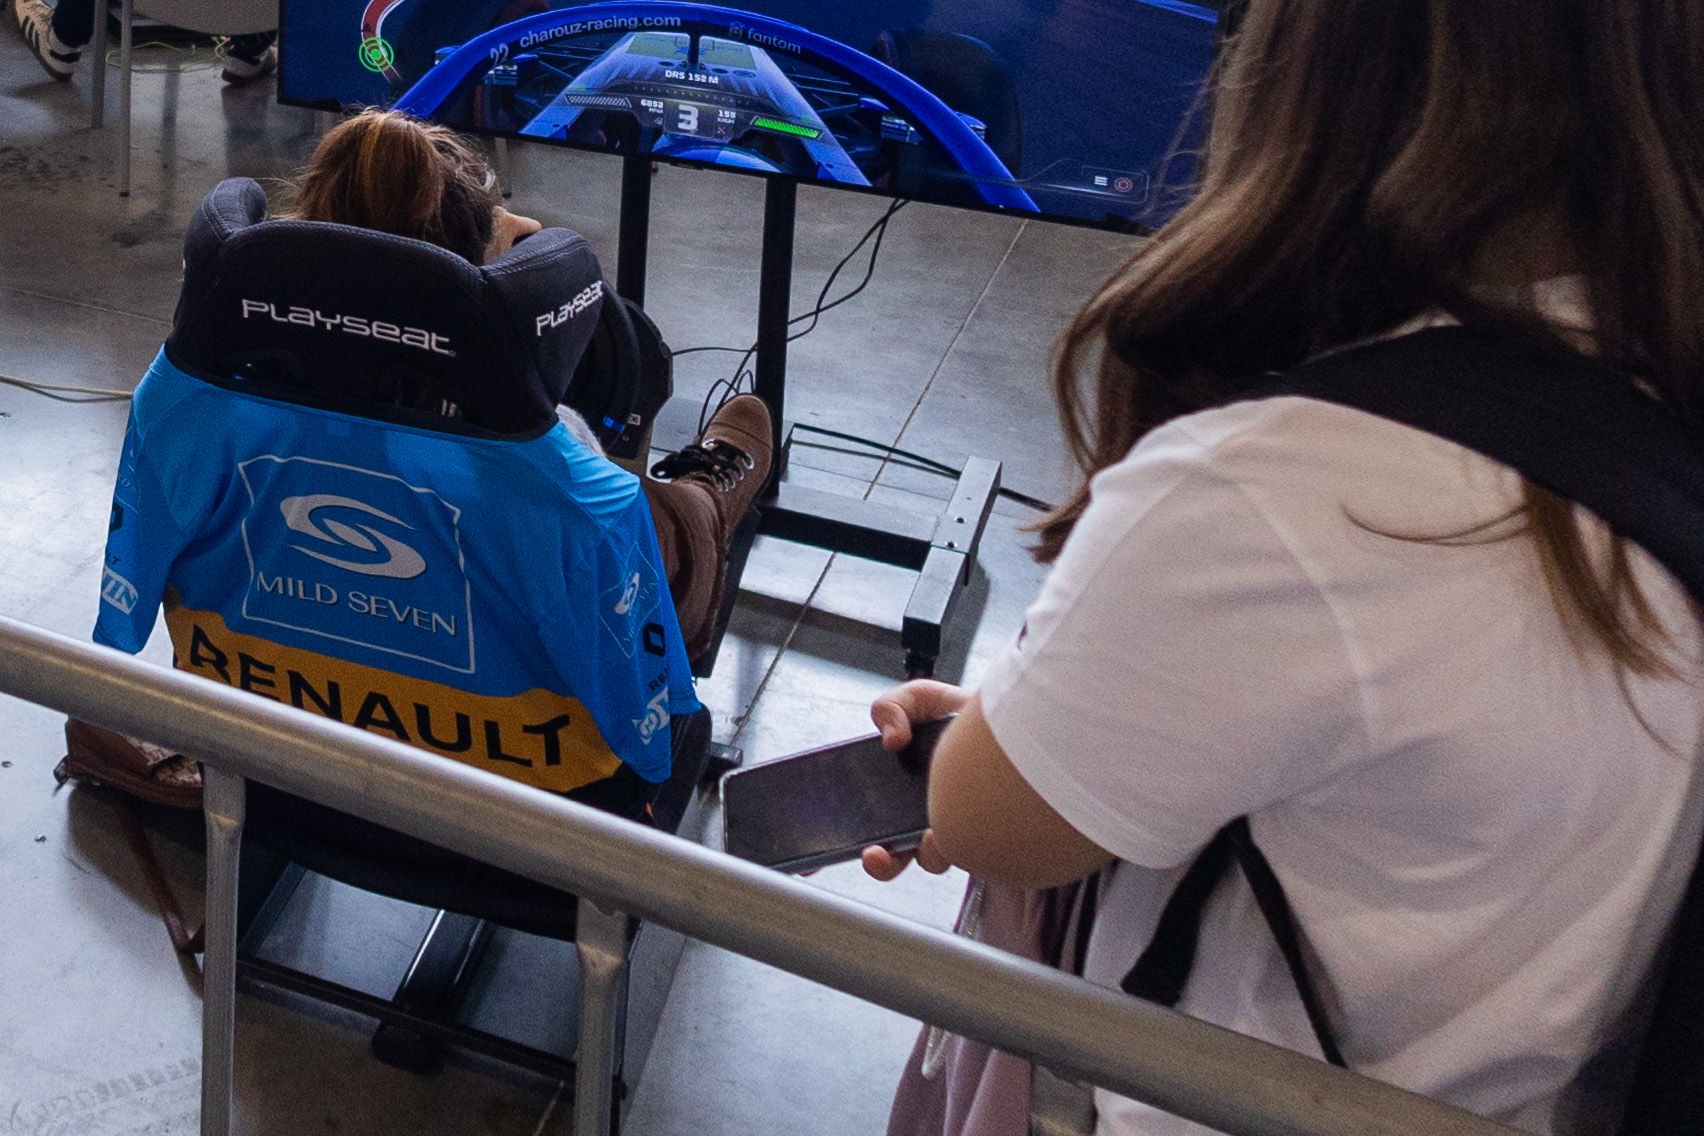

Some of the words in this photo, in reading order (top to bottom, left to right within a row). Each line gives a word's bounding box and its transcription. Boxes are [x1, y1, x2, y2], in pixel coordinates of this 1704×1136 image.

[519, 15, 682, 49] charouz-racing.com
[747, 27, 801, 55] fantom
[665, 70, 685, 80] DRS
[708, 76, 719, 84] M
[678, 103, 698, 130] 3
[256, 571, 339, 605] MILD
[347, 590, 457, 637] SEVEN
[189, 623, 571, 768] RENAULT
